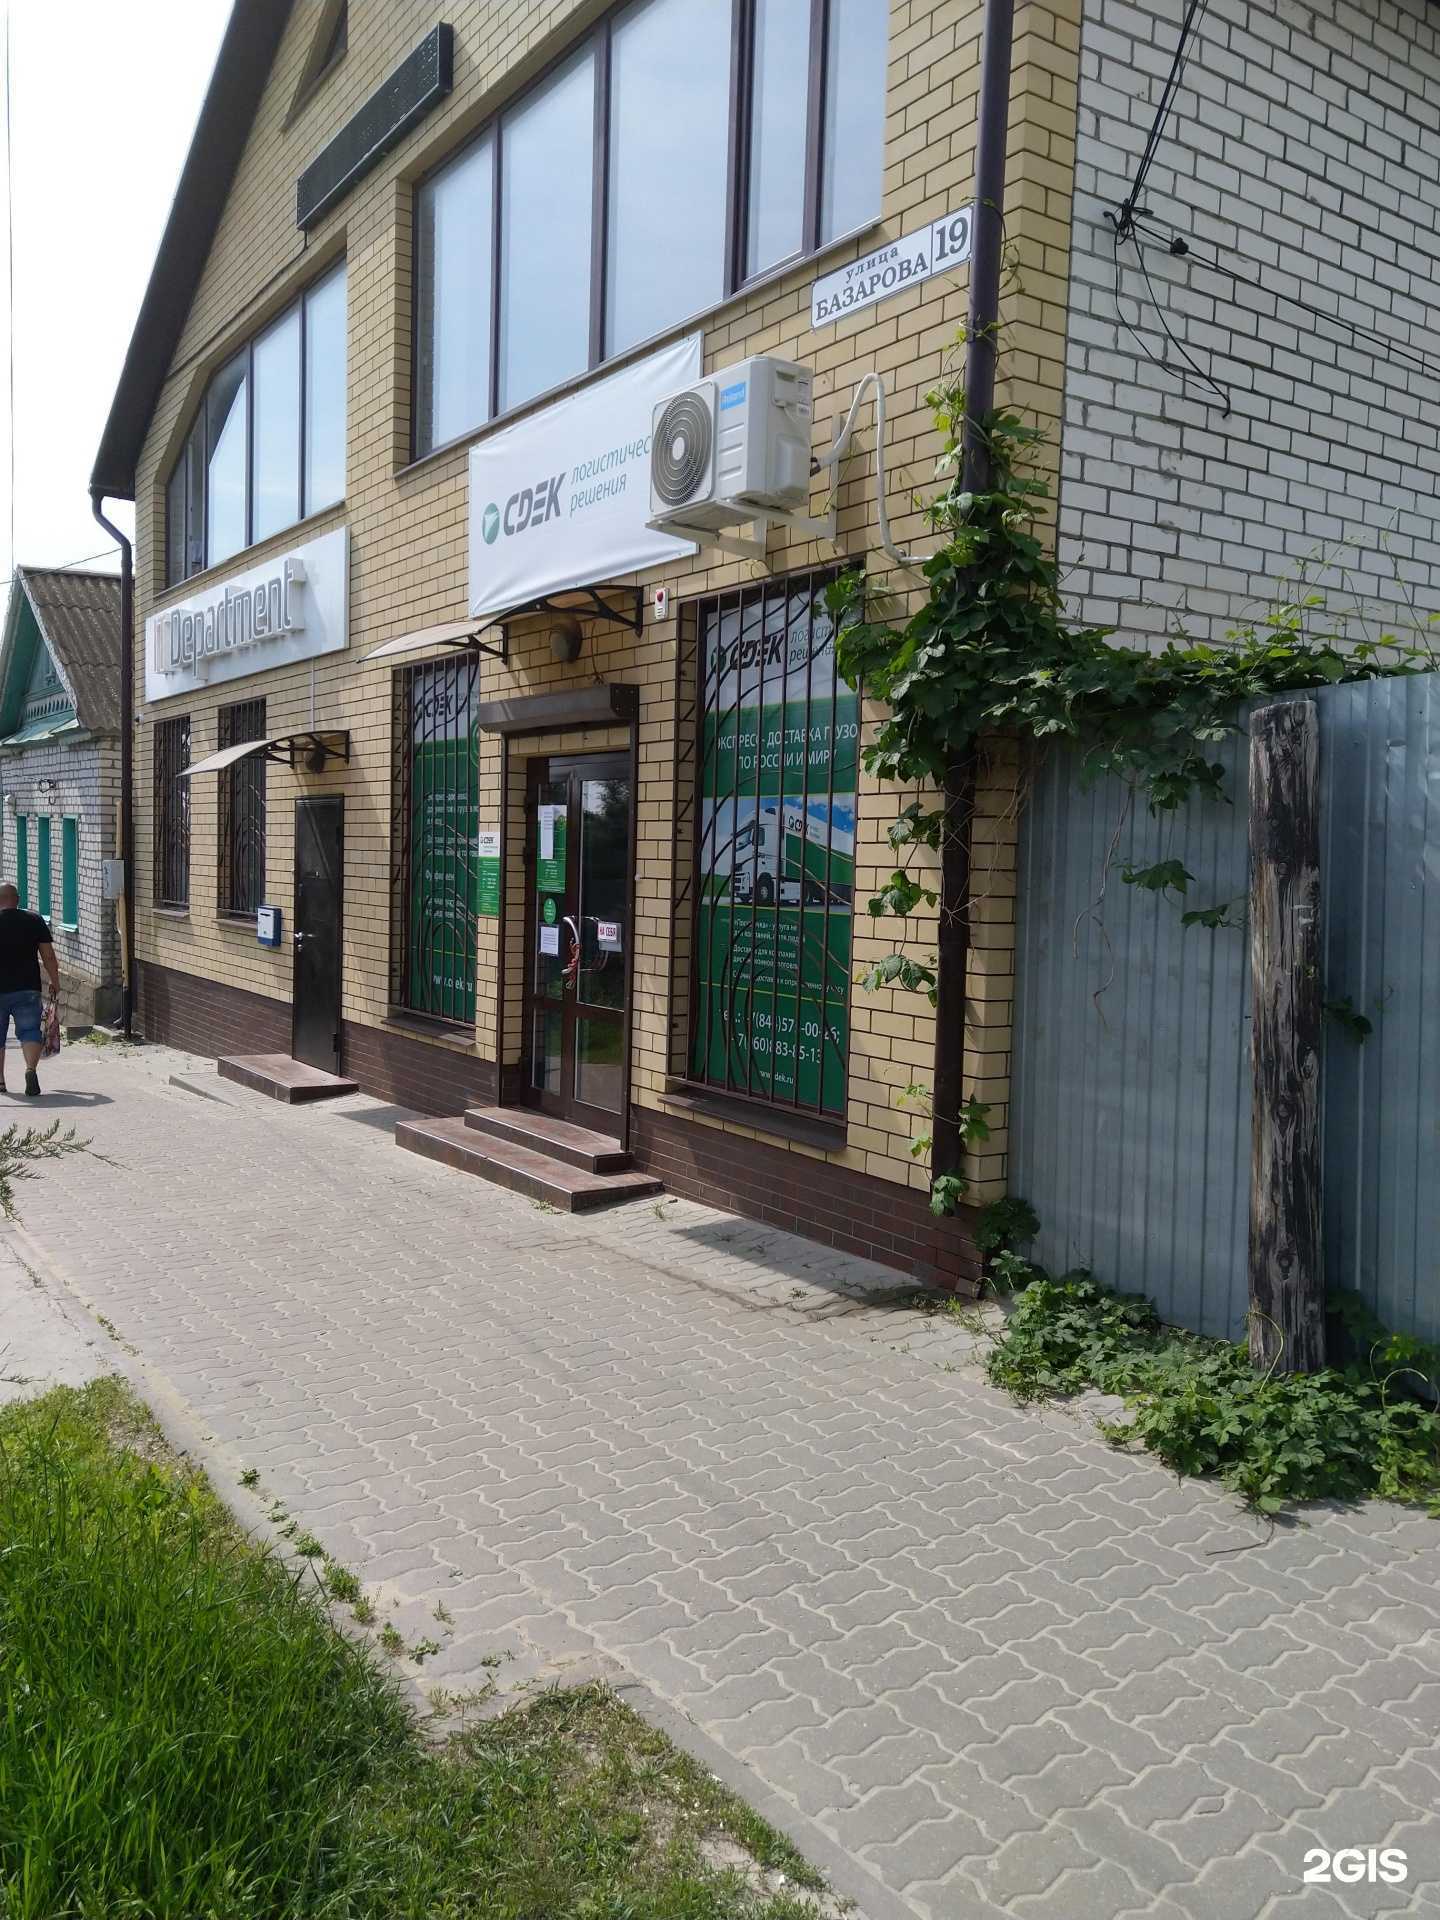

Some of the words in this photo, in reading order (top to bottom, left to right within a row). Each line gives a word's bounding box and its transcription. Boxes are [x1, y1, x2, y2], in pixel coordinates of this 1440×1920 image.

[816, 252, 929, 321] БАЗАРОВА
[935, 216, 969, 262] 19
[846, 247, 899, 284] улица
[503, 472, 567, 537] CDEK
[569, 473, 627, 518] решения
[170, 557, 304, 681] Department
[824, 723, 858, 741] ГУЗО
